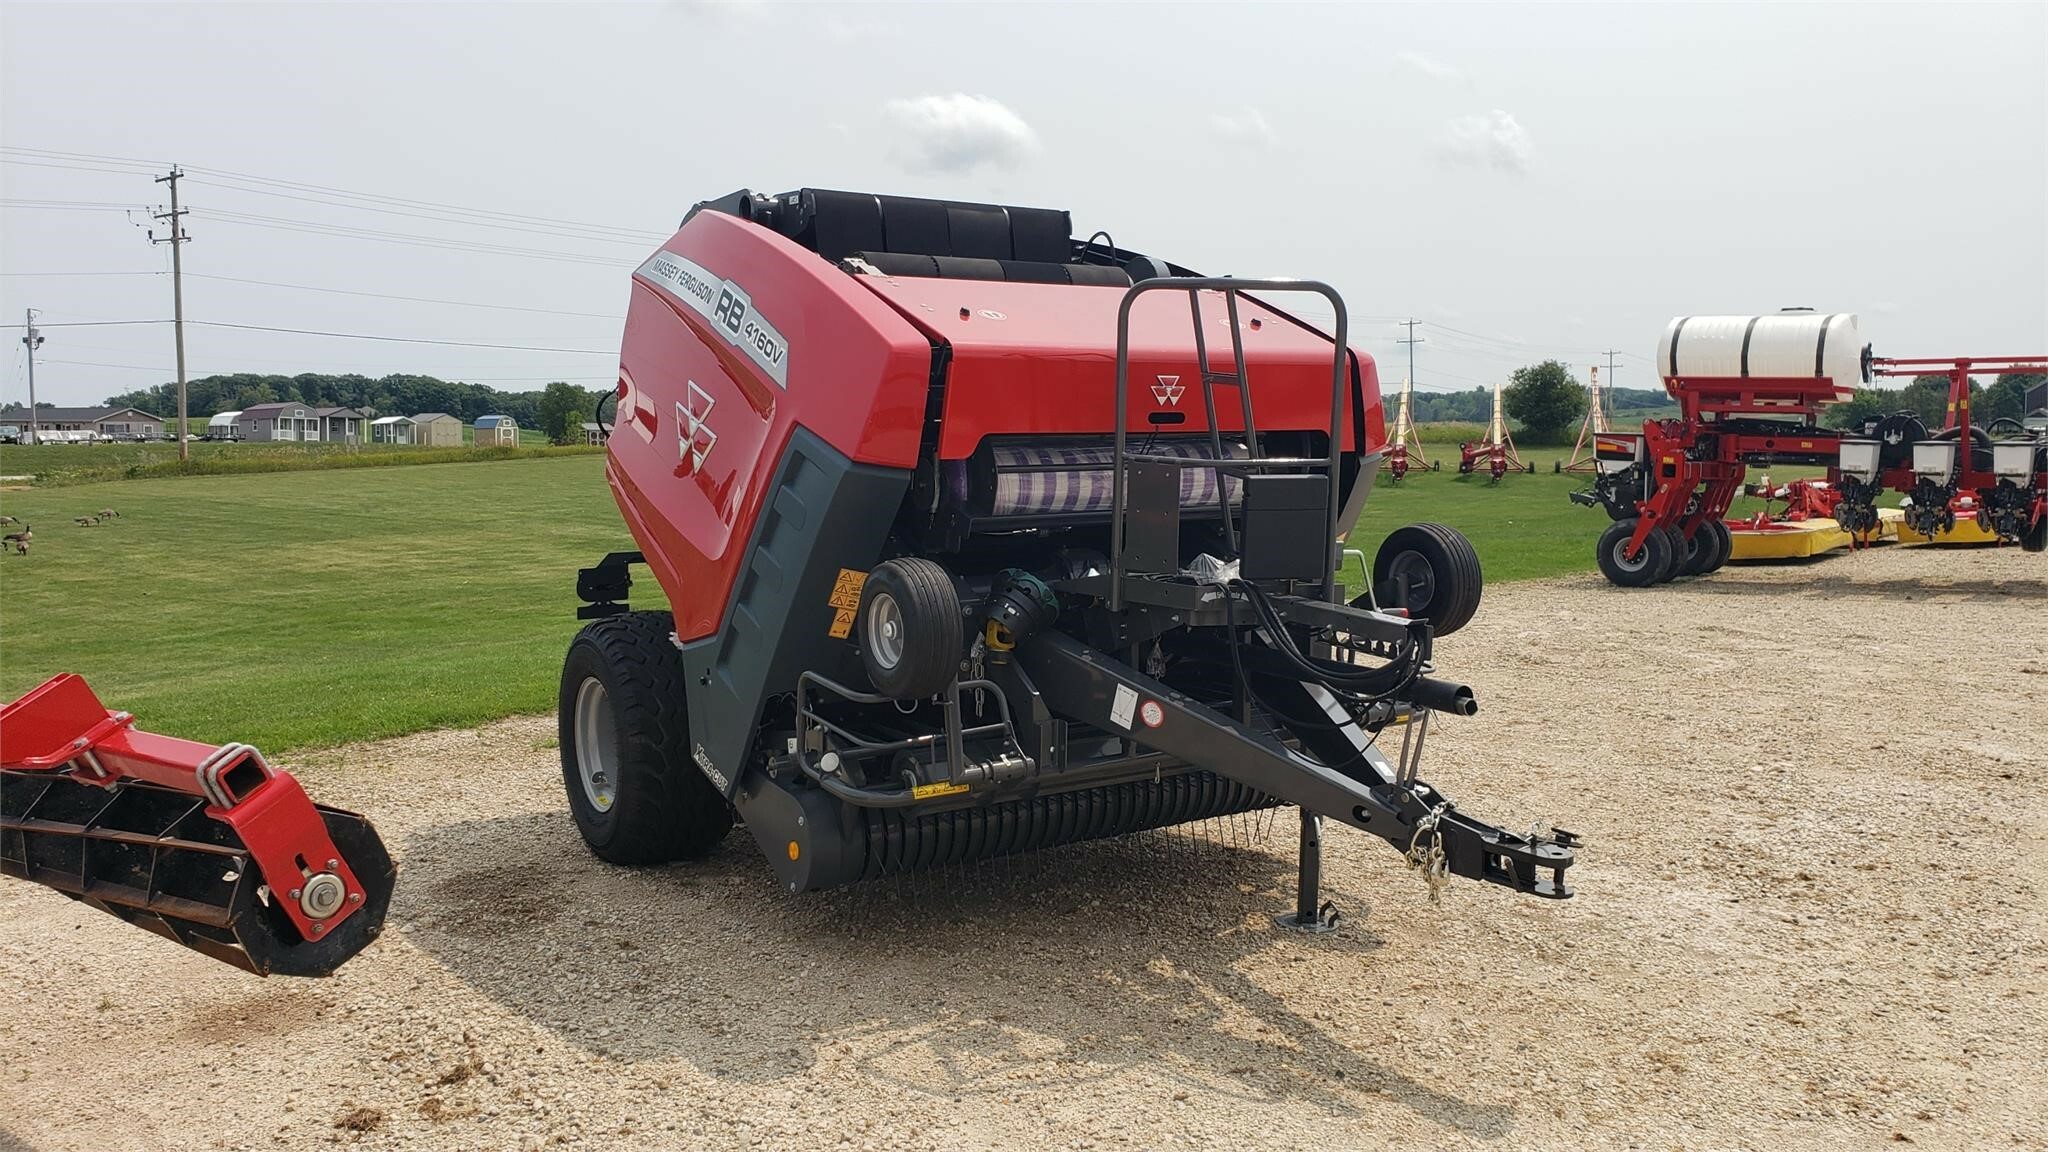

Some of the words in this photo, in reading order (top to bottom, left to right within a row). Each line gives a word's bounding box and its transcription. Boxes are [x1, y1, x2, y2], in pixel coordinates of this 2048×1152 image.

[652, 259, 681, 283] MASSEY
[678, 269, 715, 305] FERGUSON
[714, 287, 746, 335] RB
[744, 321, 784, 365] 4160V
